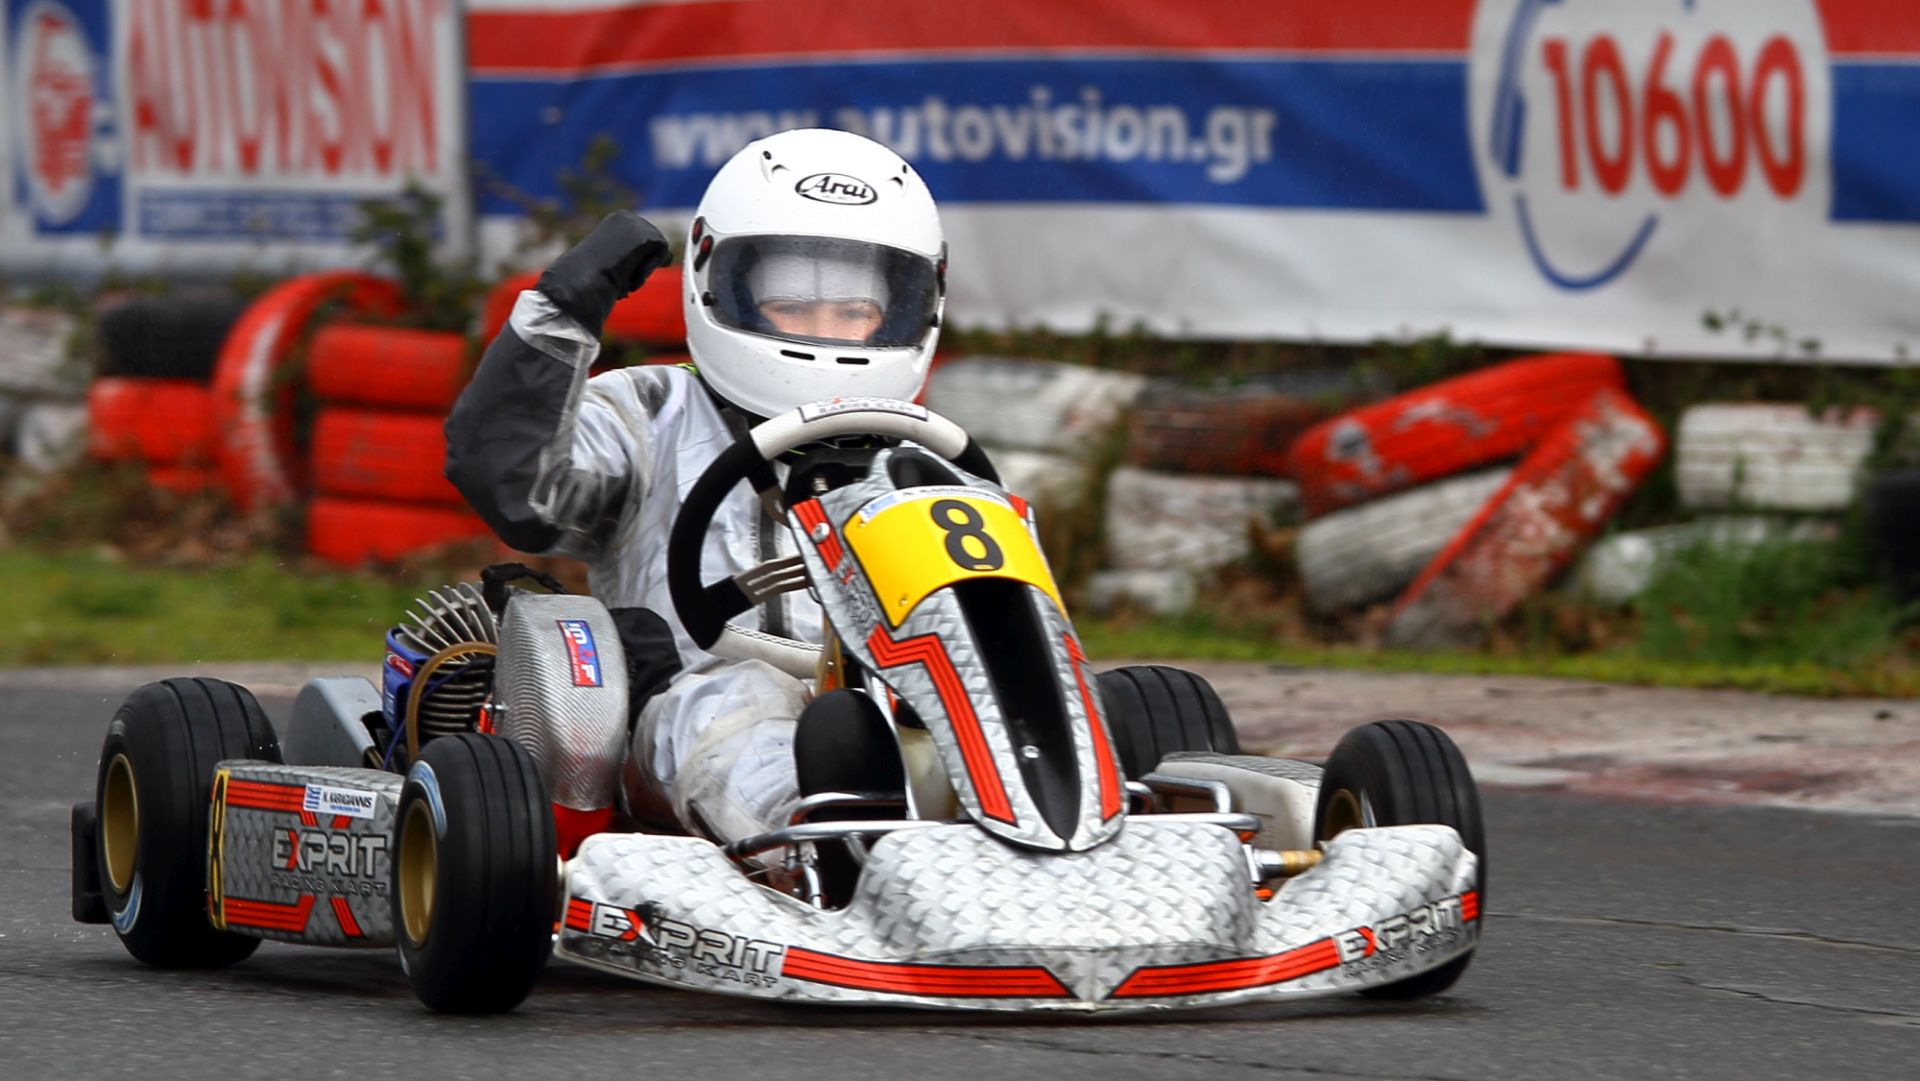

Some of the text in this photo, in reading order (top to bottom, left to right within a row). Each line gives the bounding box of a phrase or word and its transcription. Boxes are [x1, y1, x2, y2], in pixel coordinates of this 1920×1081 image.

[1541, 30, 1806, 199] 10600
[800, 175, 868, 199] Arai
[931, 499, 1004, 571] 8
[271, 827, 387, 878] EXPRIT
[593, 902, 784, 973] EXPRIT
[1335, 896, 1460, 964] EXPRIT
[697, 963, 779, 989] KART
